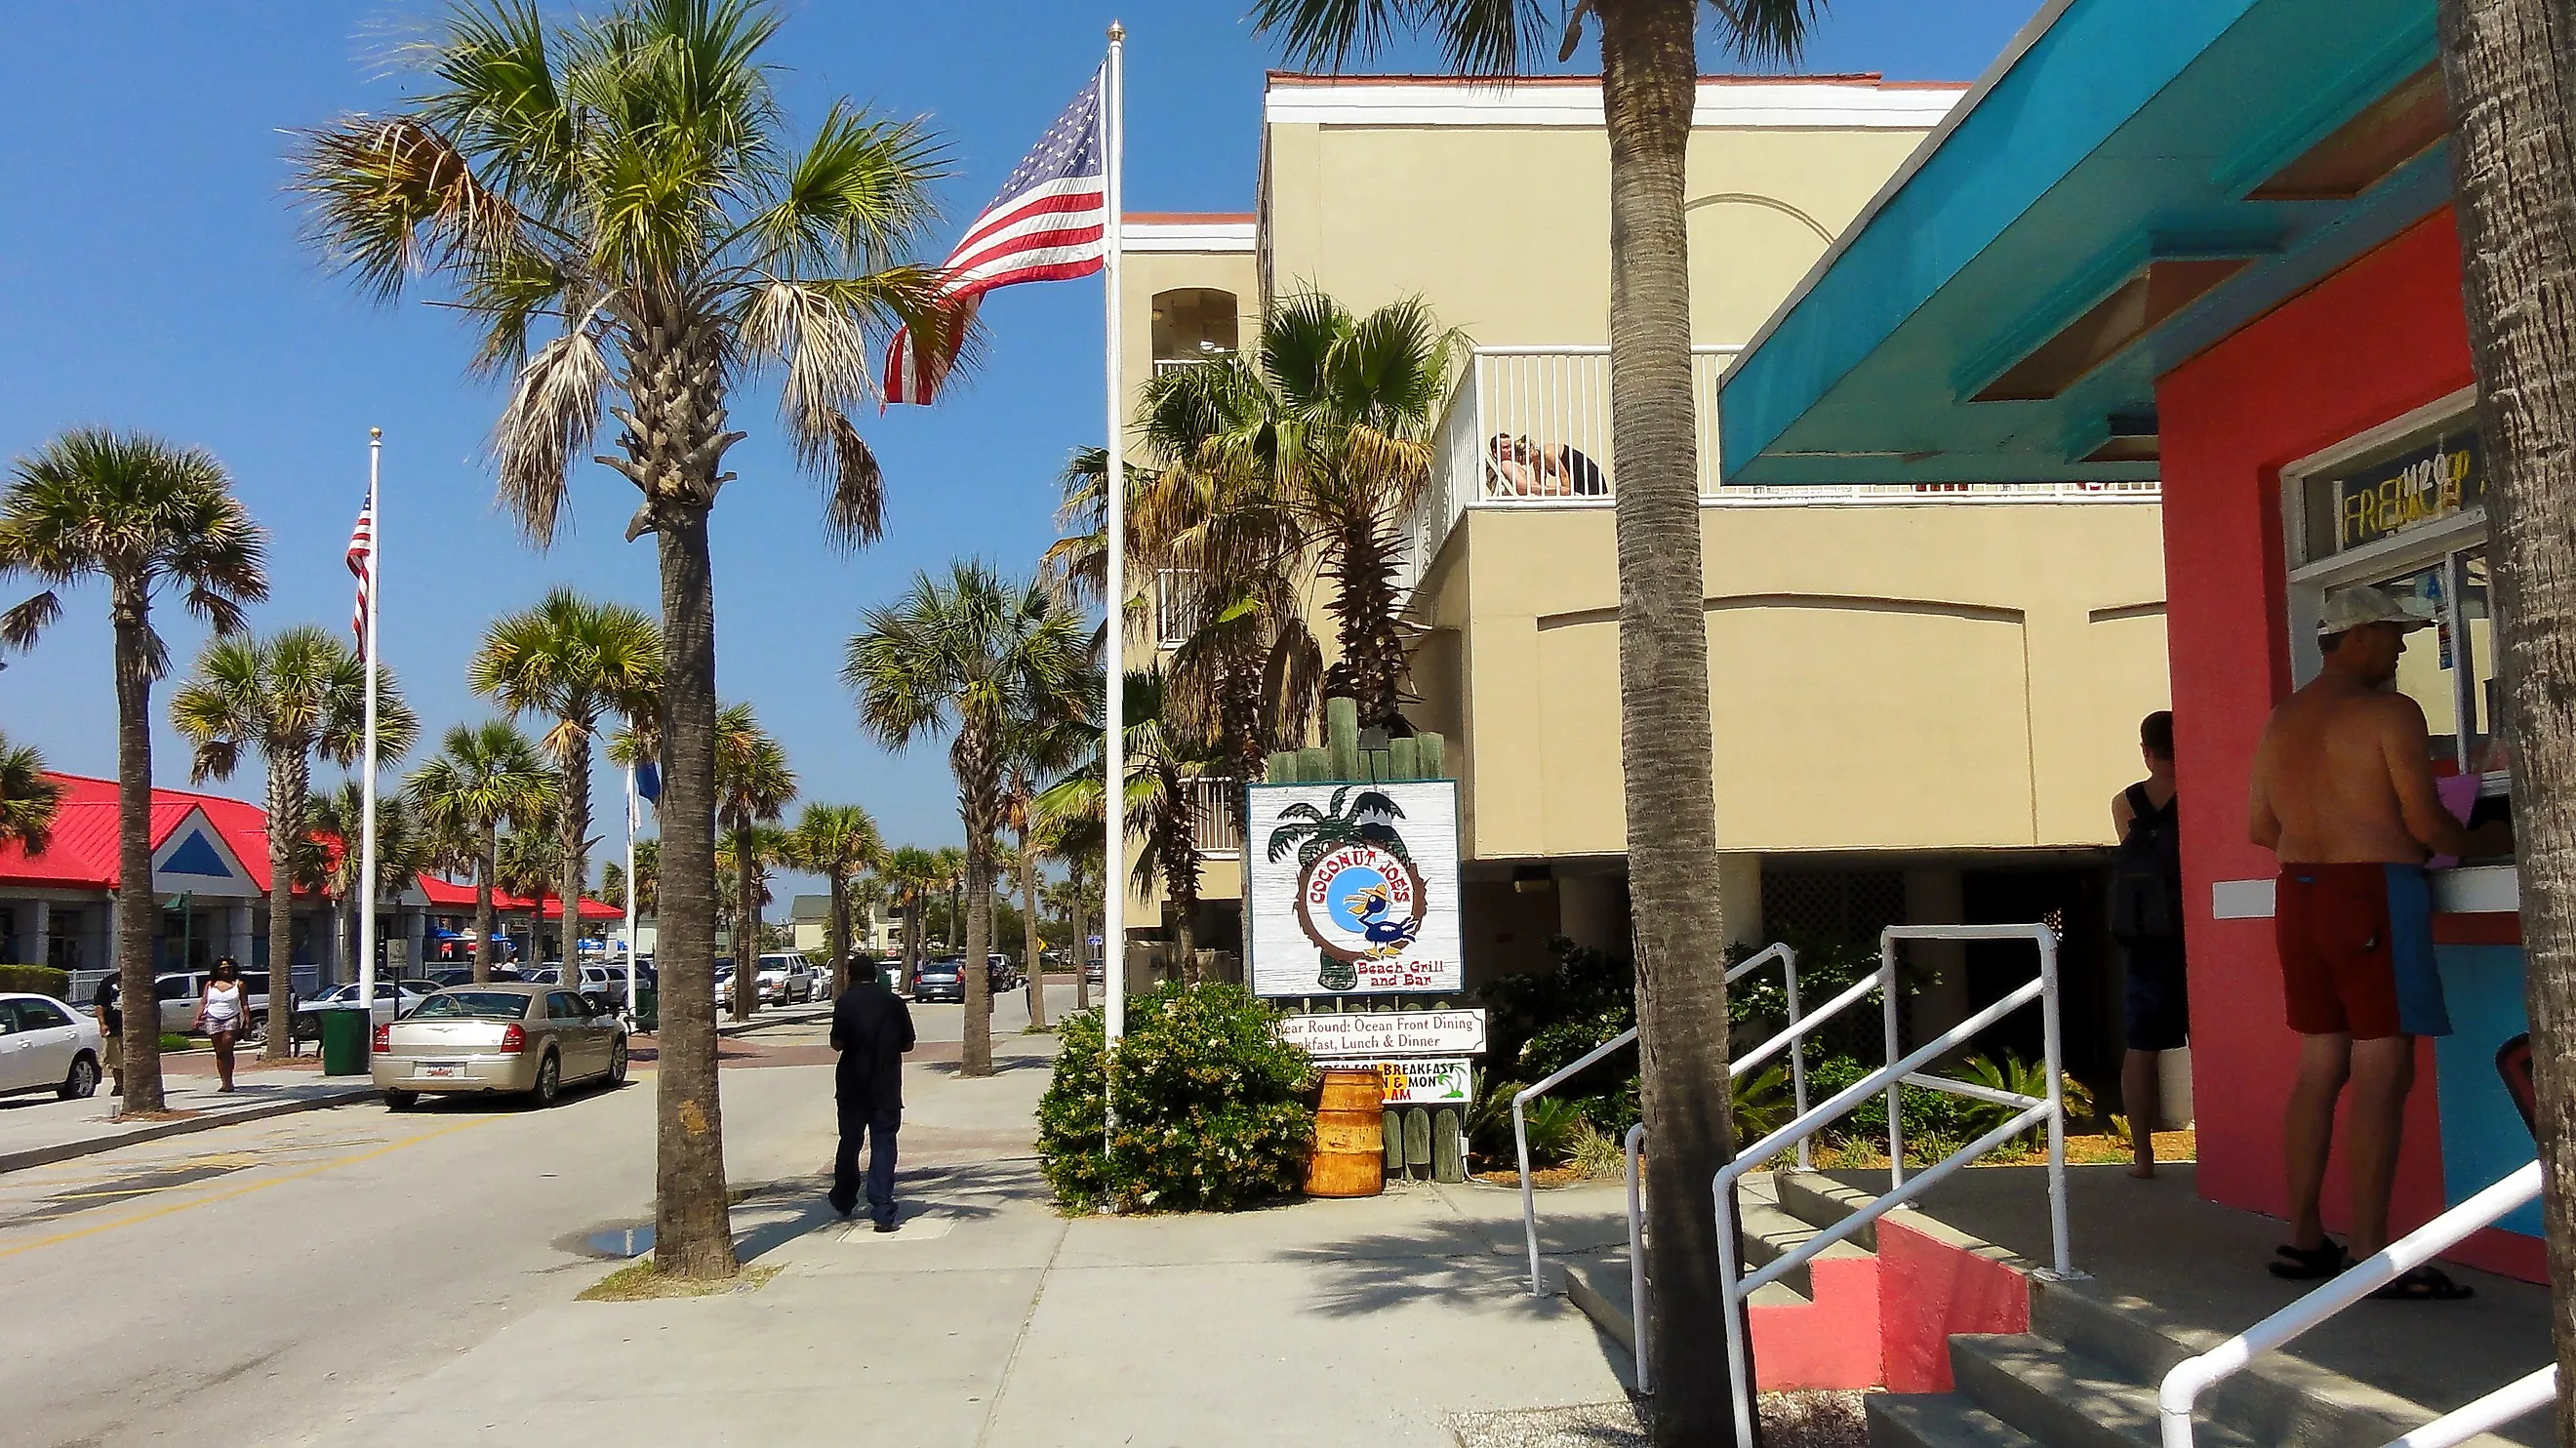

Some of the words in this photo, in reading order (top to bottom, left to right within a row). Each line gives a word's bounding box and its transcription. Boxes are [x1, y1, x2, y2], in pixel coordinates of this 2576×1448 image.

[1309, 850, 1377, 904] COCONUT
[1377, 859, 1410, 903] JOE'S
[1357, 962, 1404, 974] Beach
[1410, 960, 1444, 973] Grill
[1370, 975, 1397, 986] and
[1402, 974, 1431, 985] Bar
[1308, 1019, 1350, 1033] Round:
[1354, 1018, 1392, 1032] Ocean
[1396, 1017, 1429, 1030] Front
[1433, 1016, 1473, 1031] Dining
[1289, 1036, 1338, 1052] akfast,
[1342, 1035, 1379, 1049] Lunch
[1384, 1034, 1394, 1048] &
[1398, 1034, 1440, 1047] Dinner
[1383, 1063, 1455, 1075] BREAKFAST
[1393, 1076, 1404, 1088] &
[1407, 1075, 1436, 1087] MON
[1390, 1089, 1412, 1101] AM
